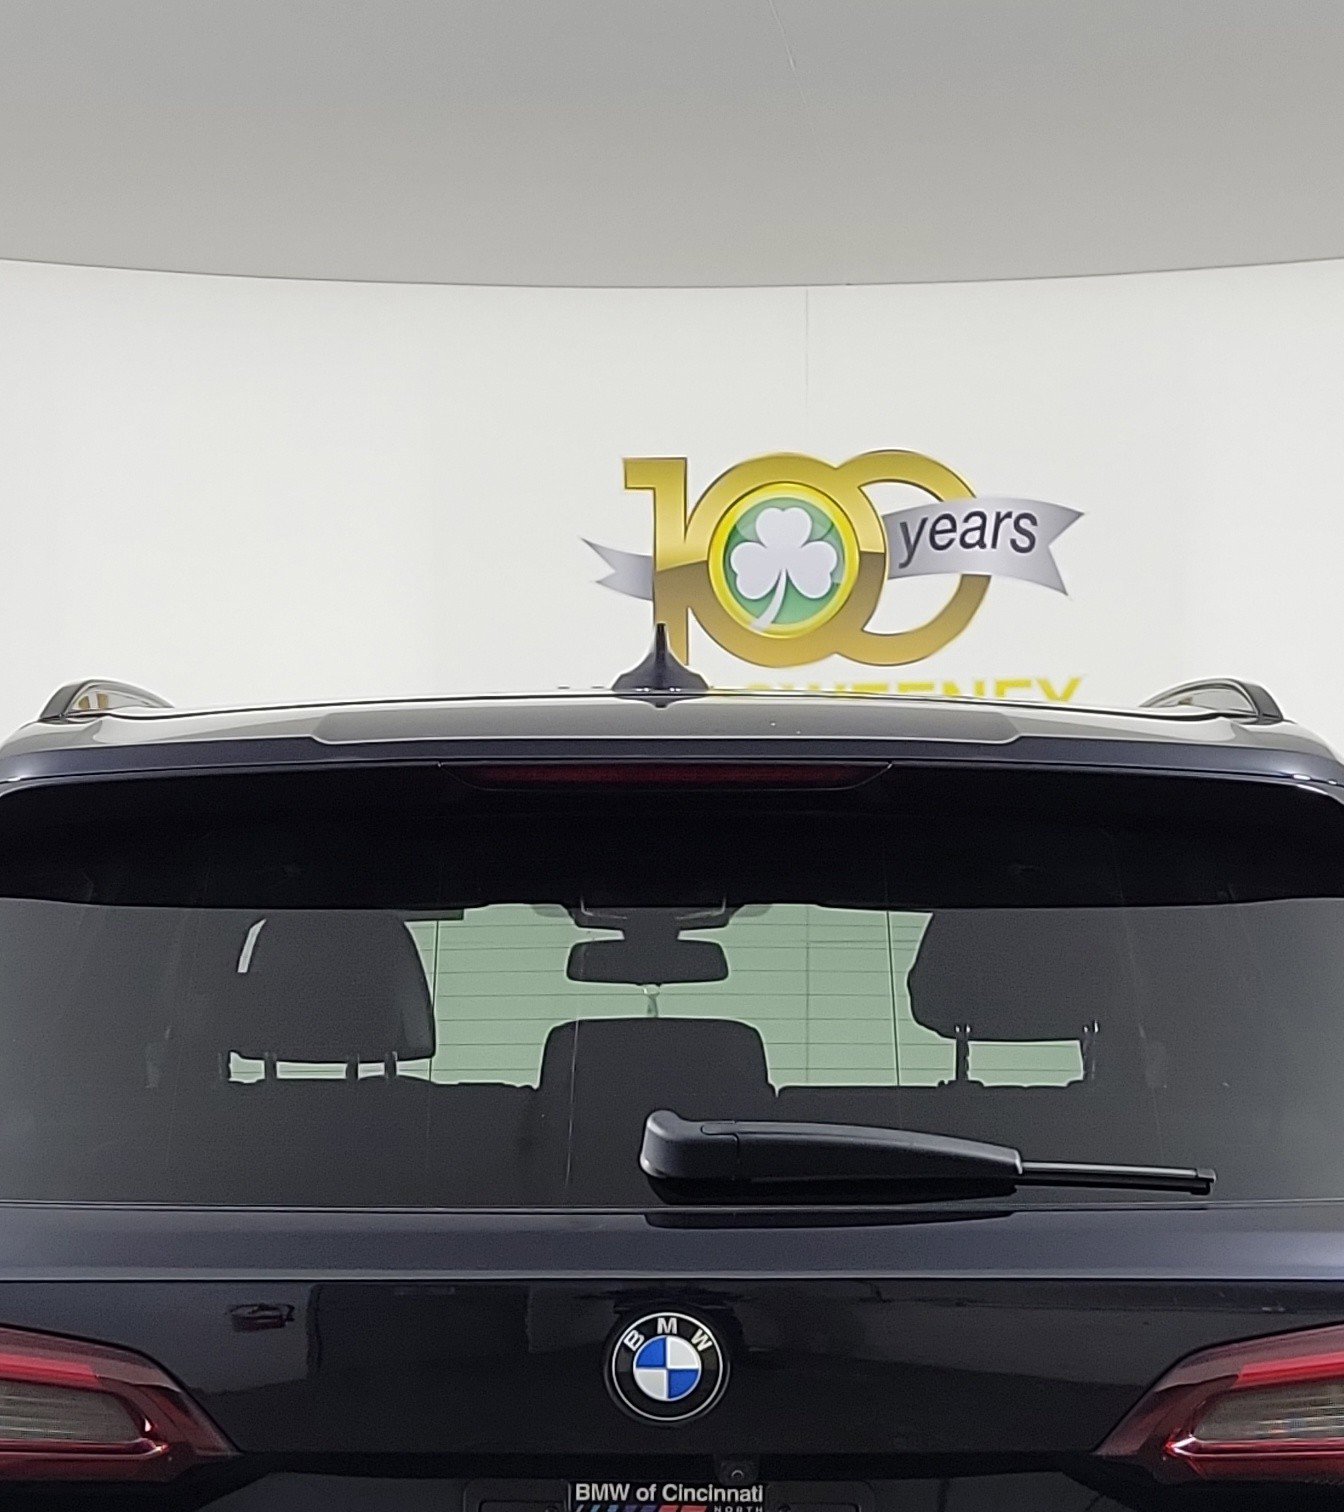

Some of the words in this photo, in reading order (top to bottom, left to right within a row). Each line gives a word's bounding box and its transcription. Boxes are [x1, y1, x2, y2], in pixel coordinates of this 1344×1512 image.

[898, 509, 1038, 569] years
[623, 1316, 714, 1352] BMW
[575, 1483, 630, 1502] BMW
[636, 1483, 657, 1502] of
[661, 1483, 764, 1503] Cincinnati
